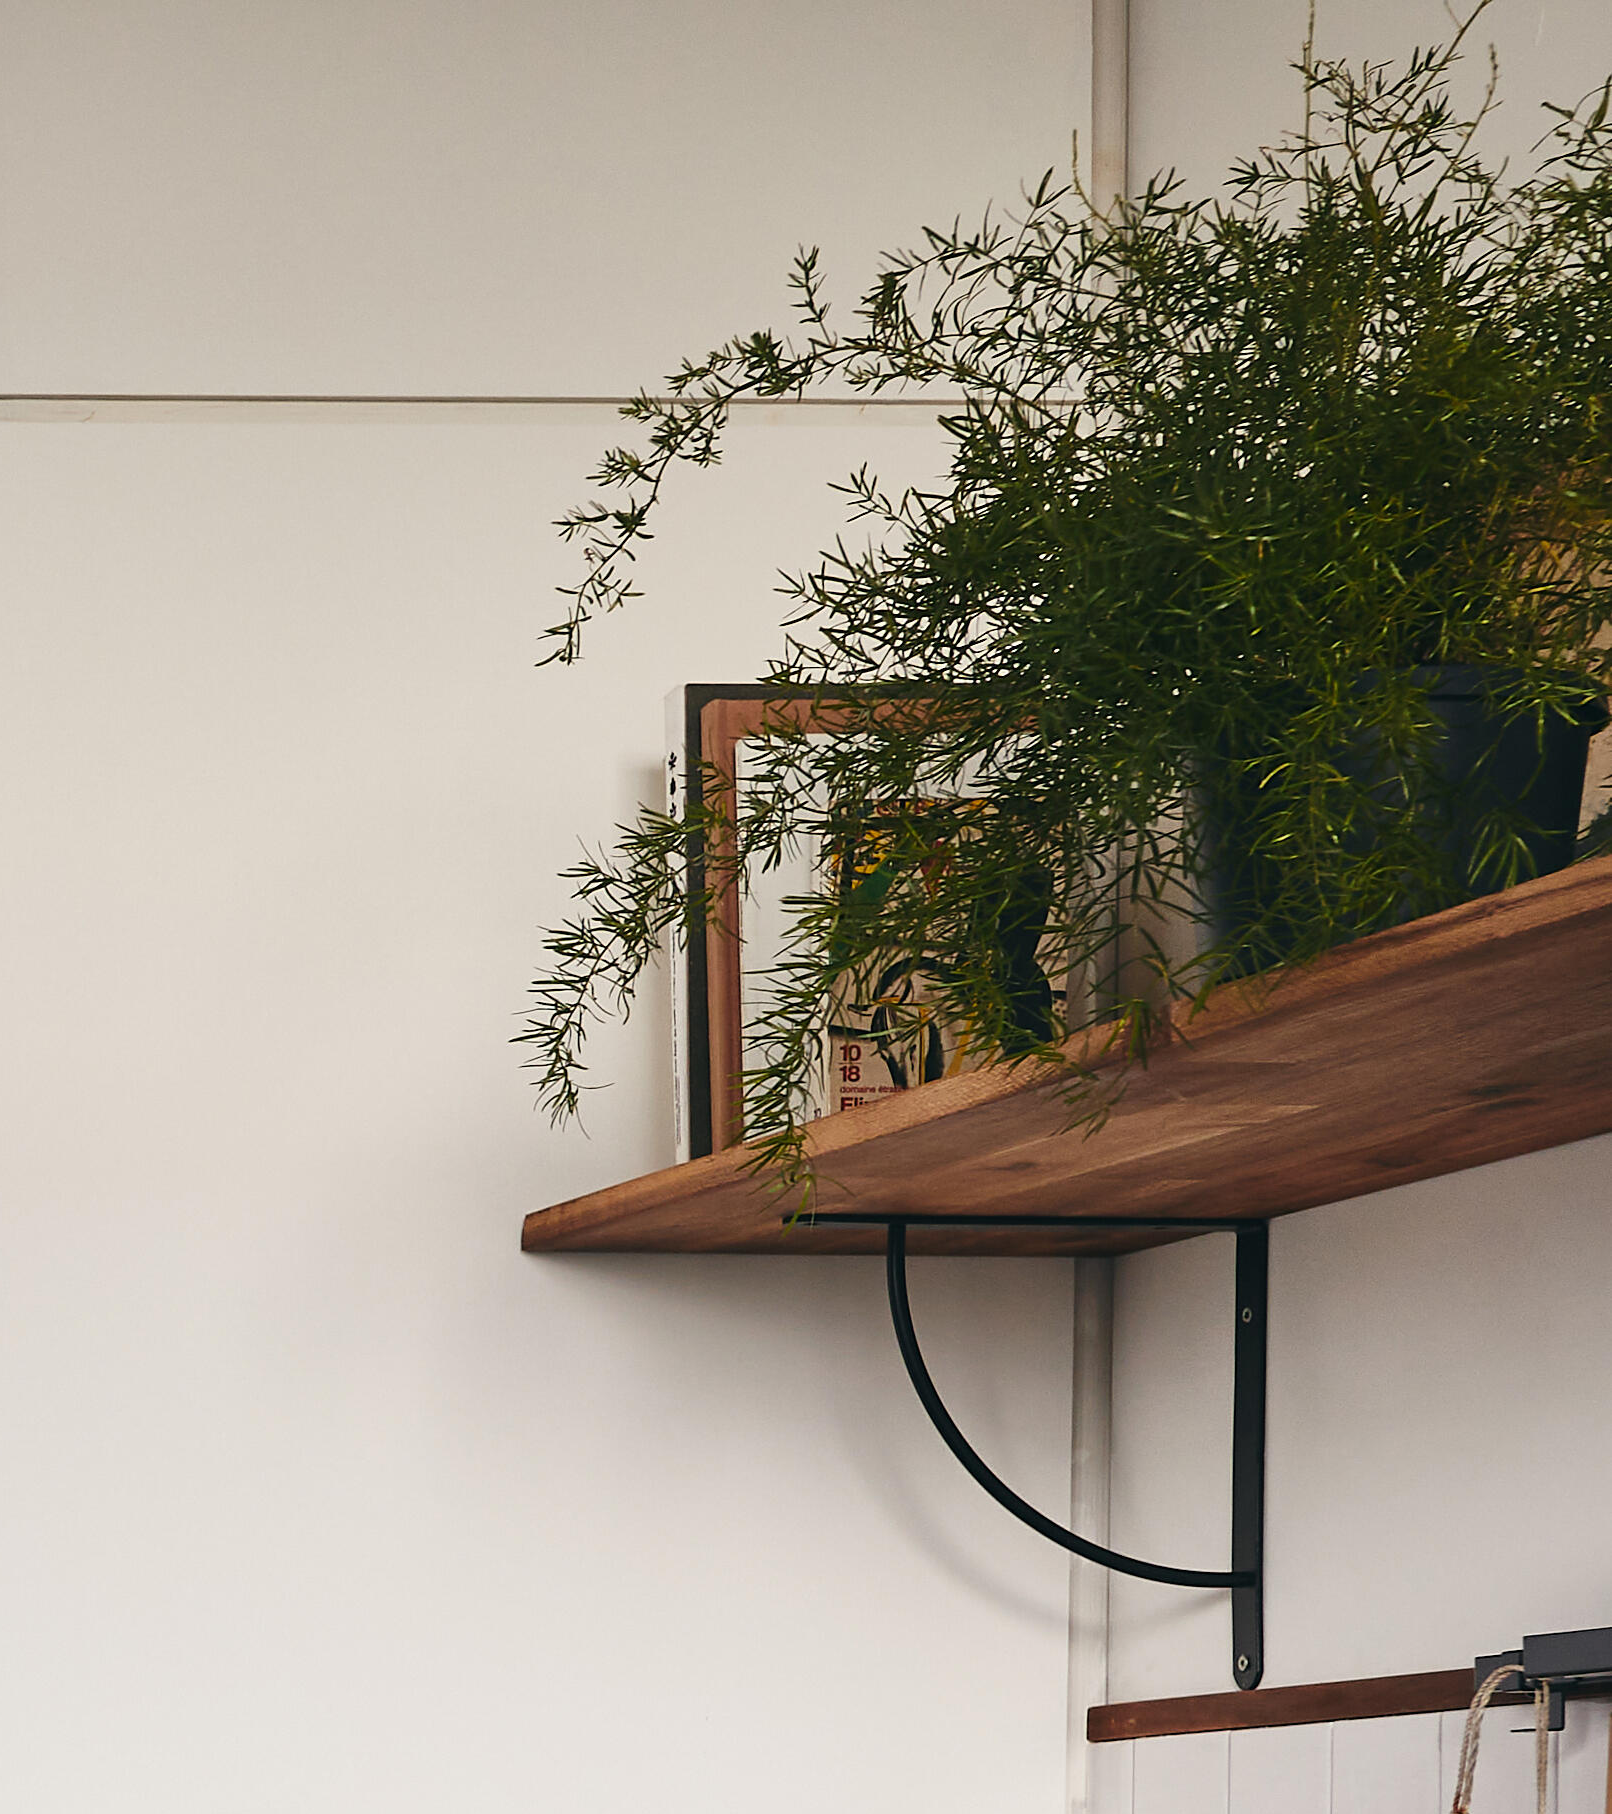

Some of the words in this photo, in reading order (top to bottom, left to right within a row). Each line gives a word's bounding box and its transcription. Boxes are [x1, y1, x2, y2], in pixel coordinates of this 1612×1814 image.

[839, 1044, 862, 1062] 10
[839, 1065, 861, 1082] 18
[839, 1085, 876, 1094] domaine
